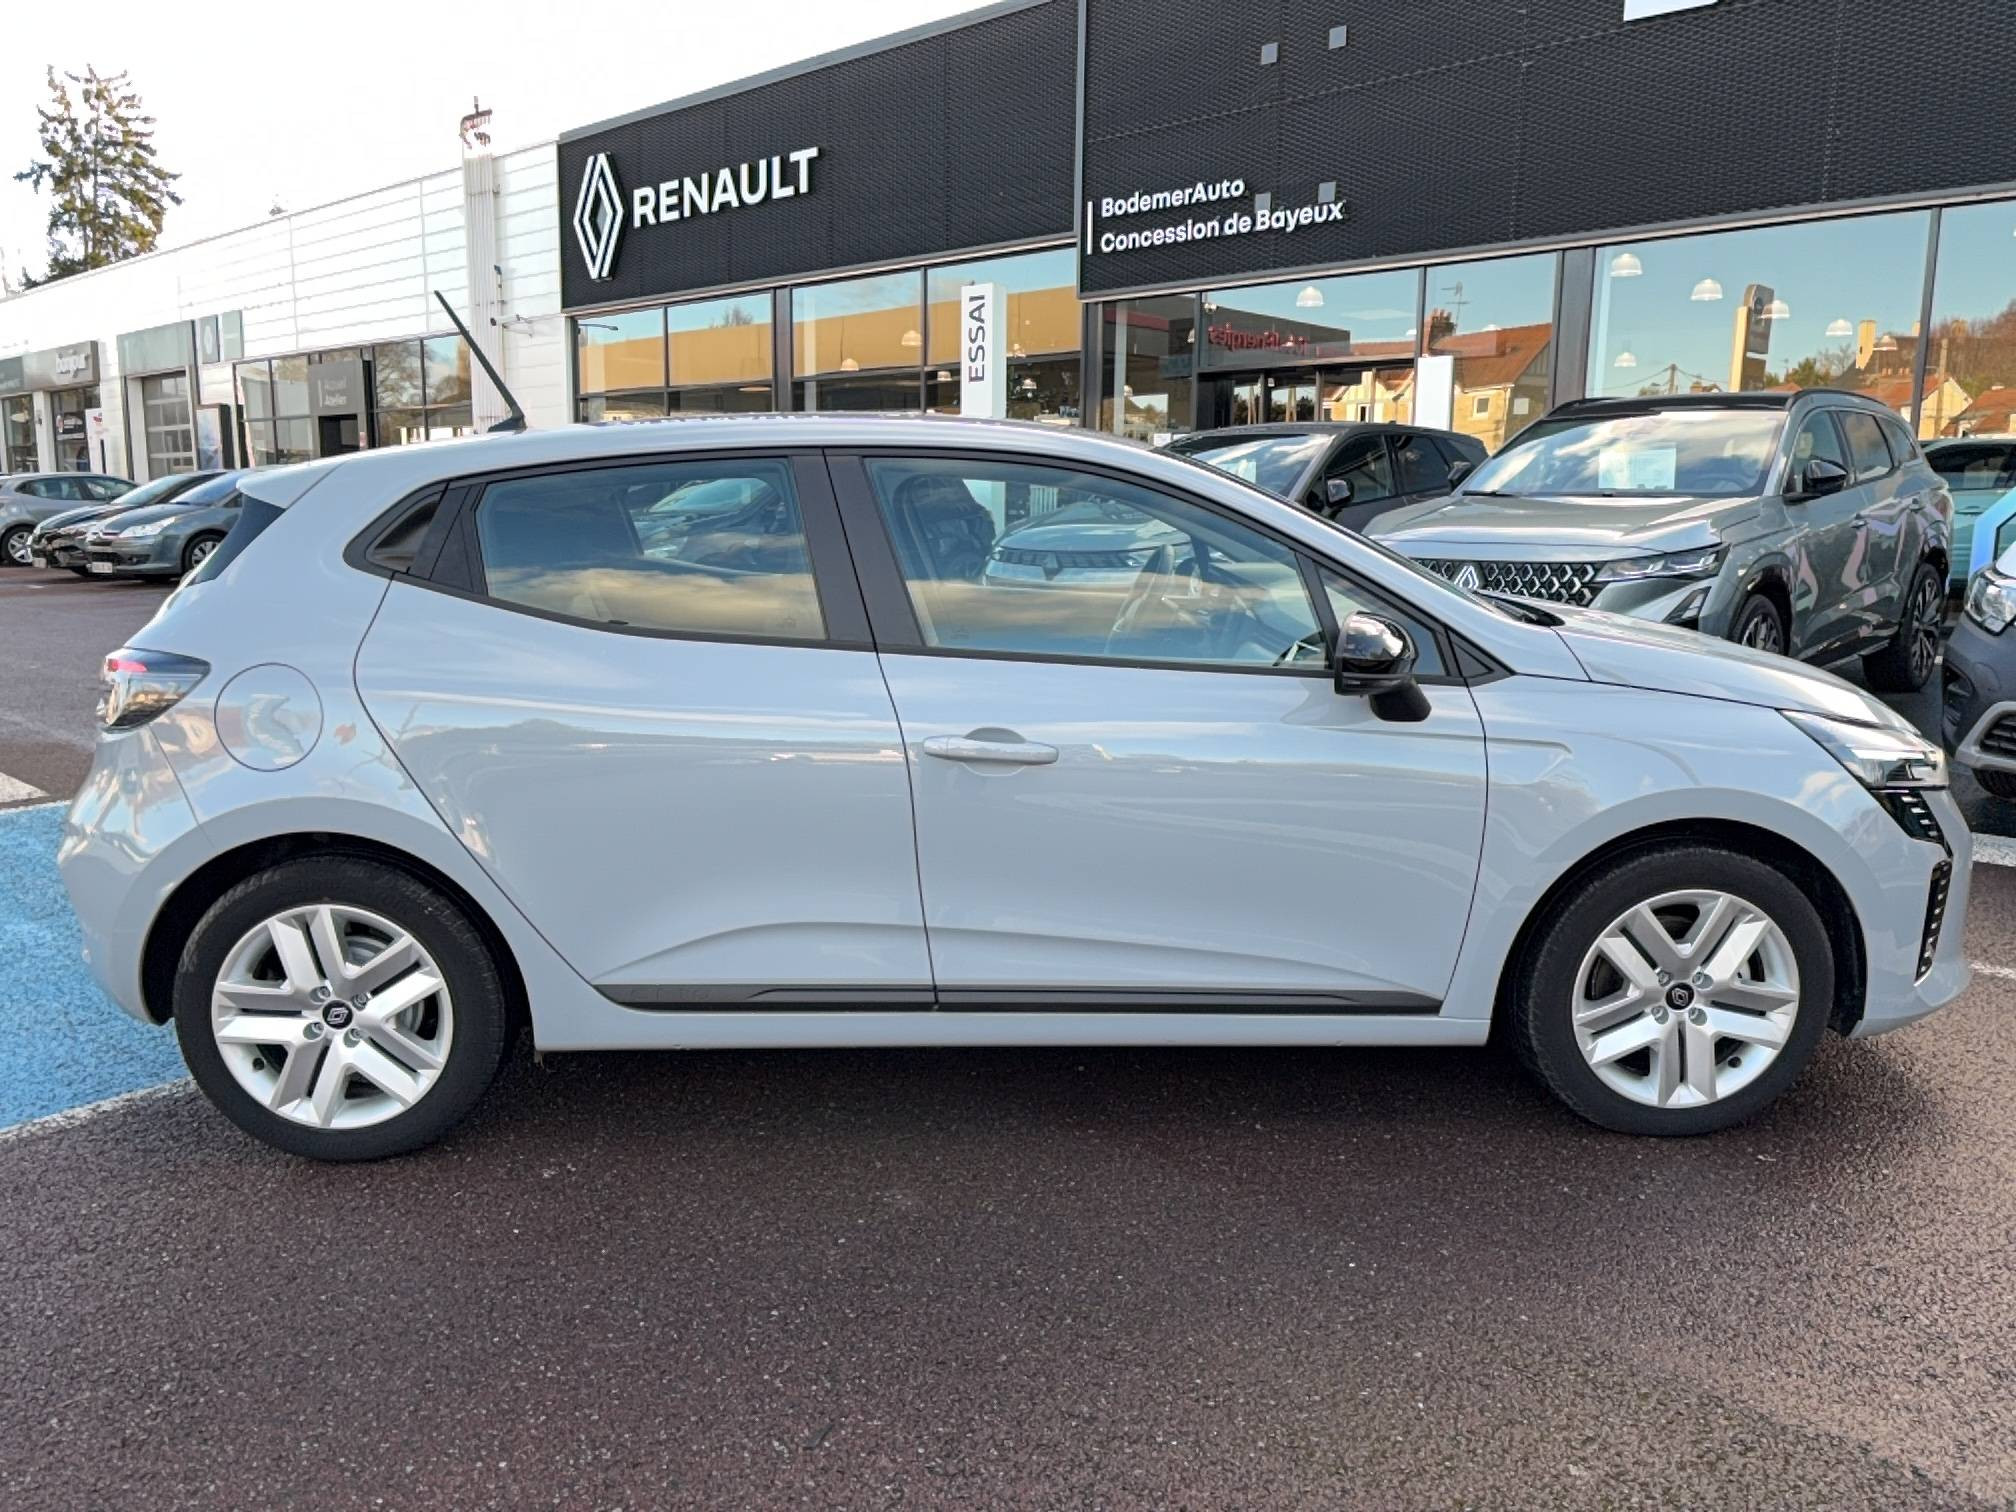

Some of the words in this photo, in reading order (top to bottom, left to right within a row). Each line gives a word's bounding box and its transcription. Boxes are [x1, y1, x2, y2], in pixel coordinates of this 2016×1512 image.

[633, 146, 819, 228] RENAULT
[1101, 179, 1245, 218] BodemerAuto
[1100, 218, 1219, 253] Concession
[1223, 211, 1252, 235] de
[1255, 200, 1344, 233] Bayeux
[968, 294, 986, 383] ESSAI
